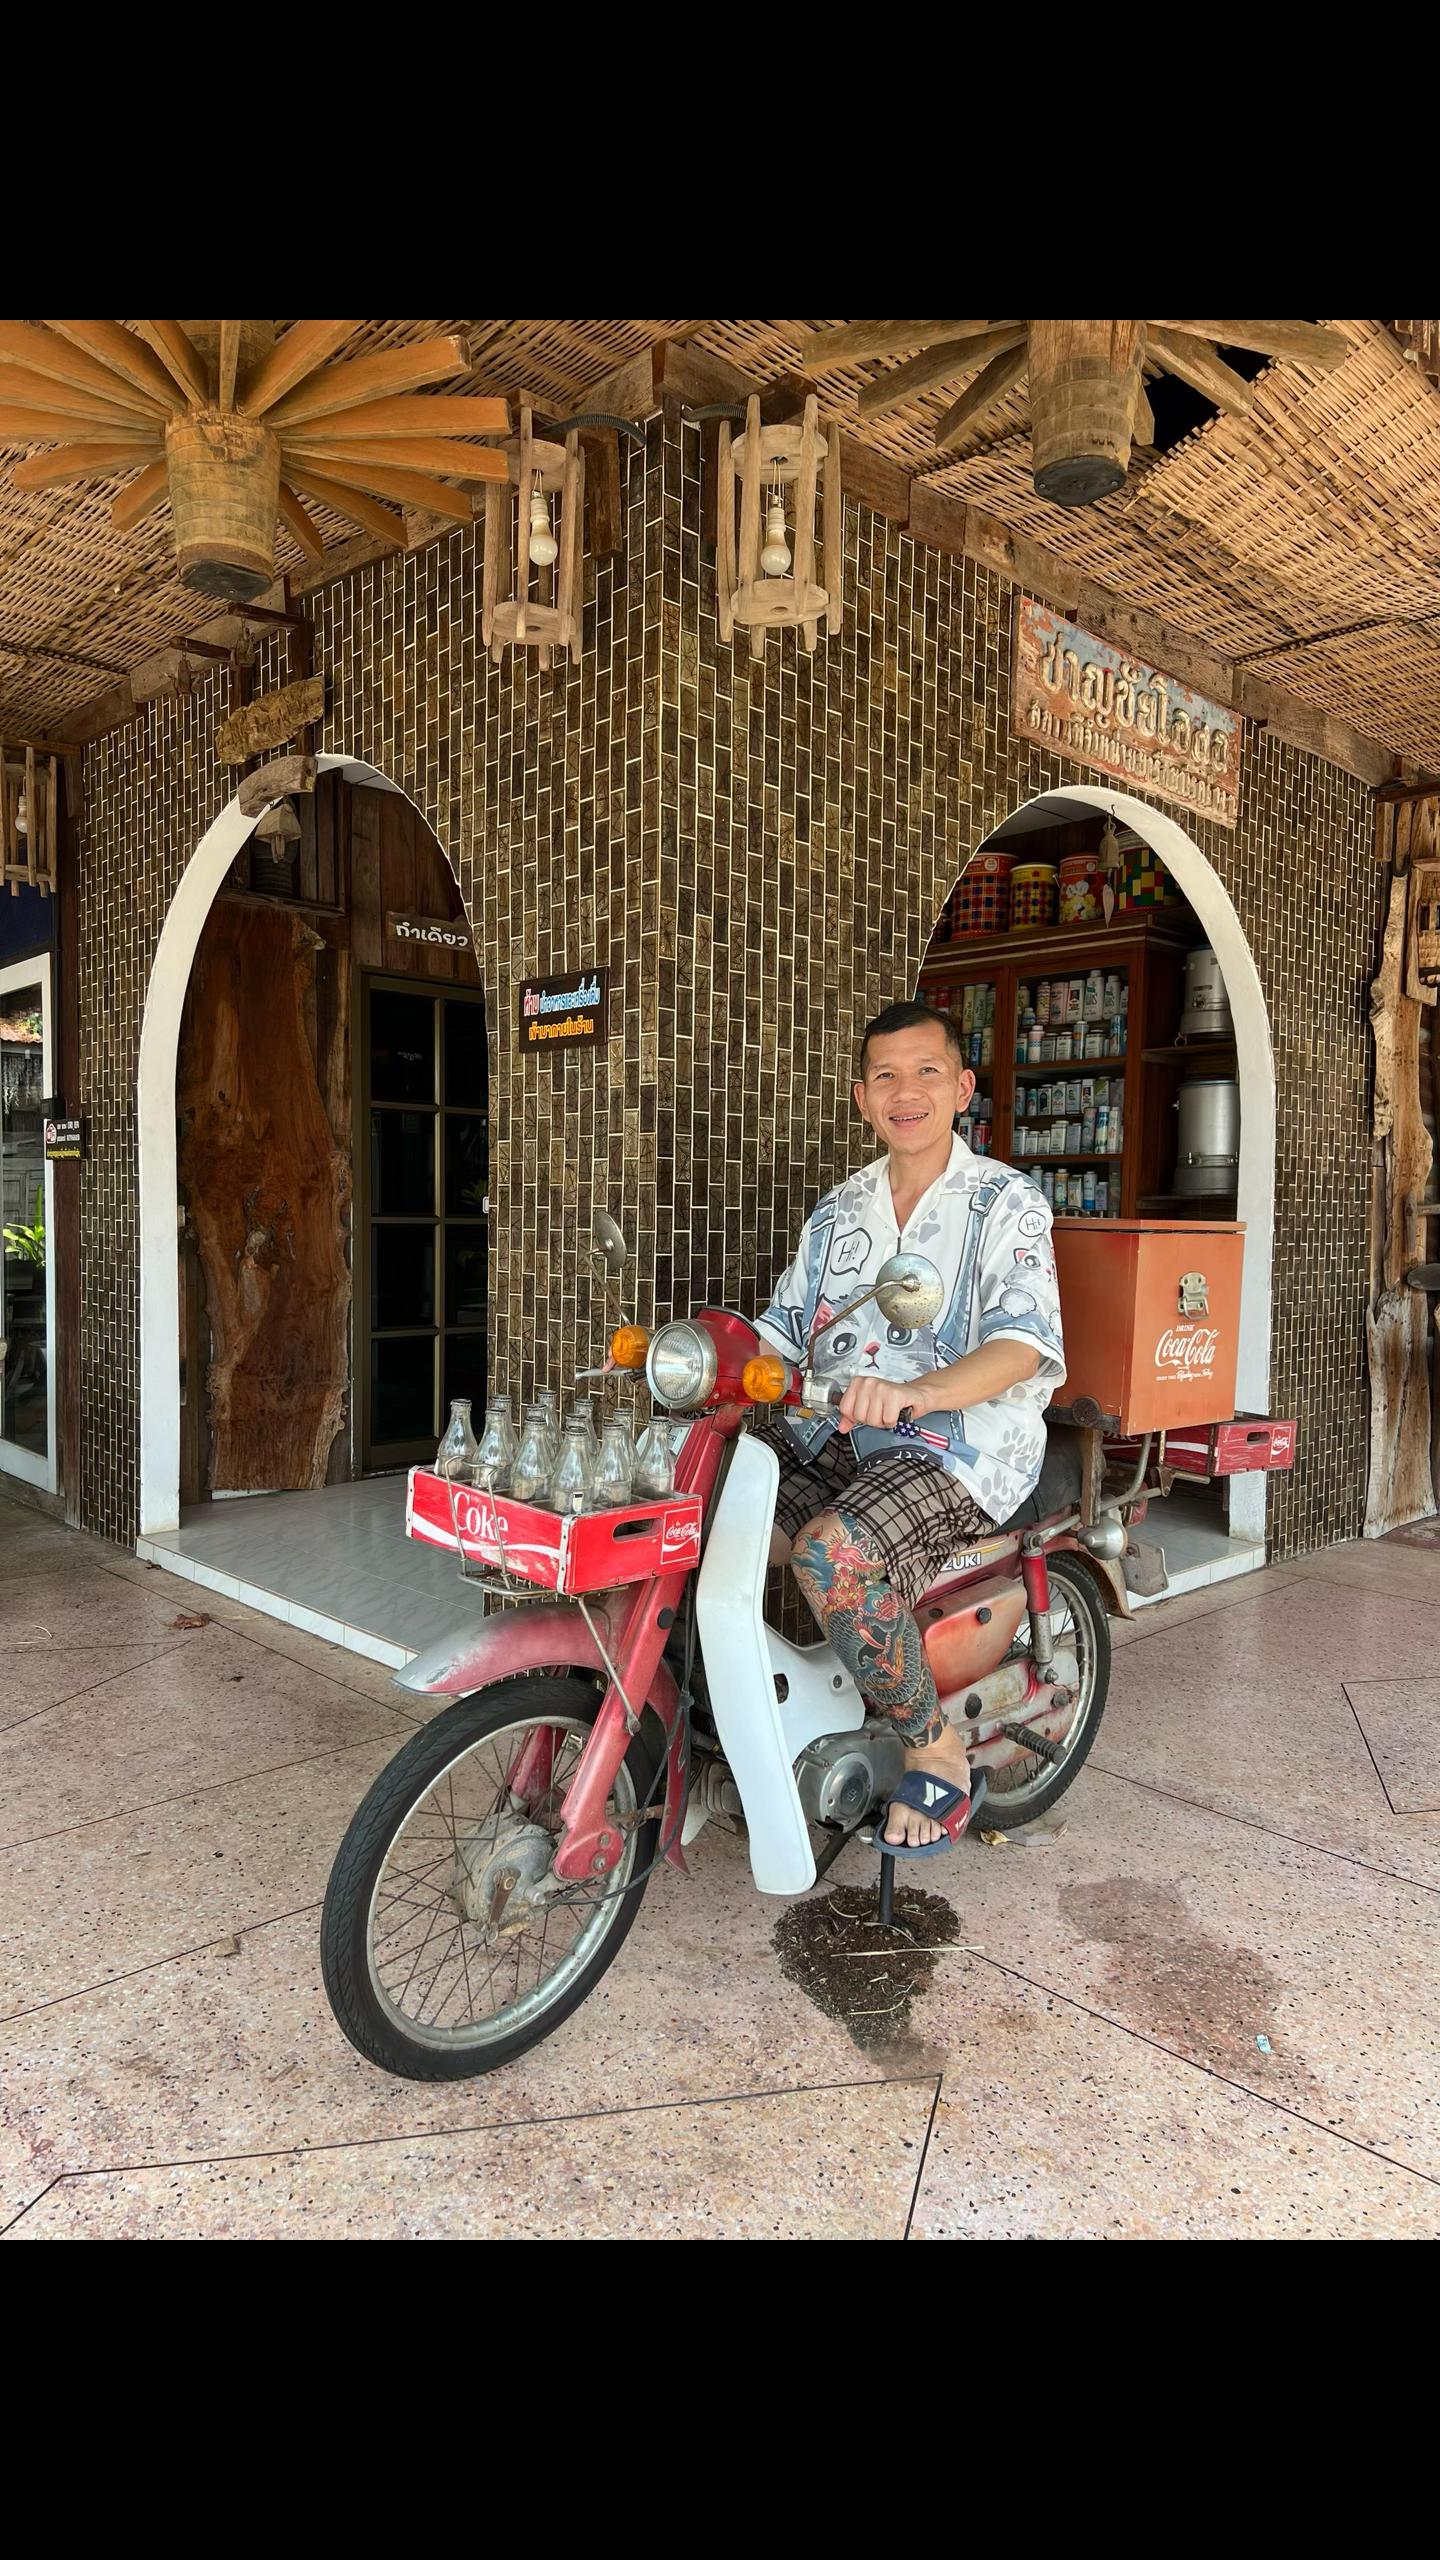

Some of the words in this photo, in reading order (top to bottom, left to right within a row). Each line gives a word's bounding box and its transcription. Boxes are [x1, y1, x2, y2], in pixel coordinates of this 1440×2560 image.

[1042, 632, 1228, 774] ชาญชัยโอสถ
[524, 988, 539, 1016] ห้าม
[454, 1491, 509, 1545] Coke
[941, 1552, 981, 1571] ZUKI
